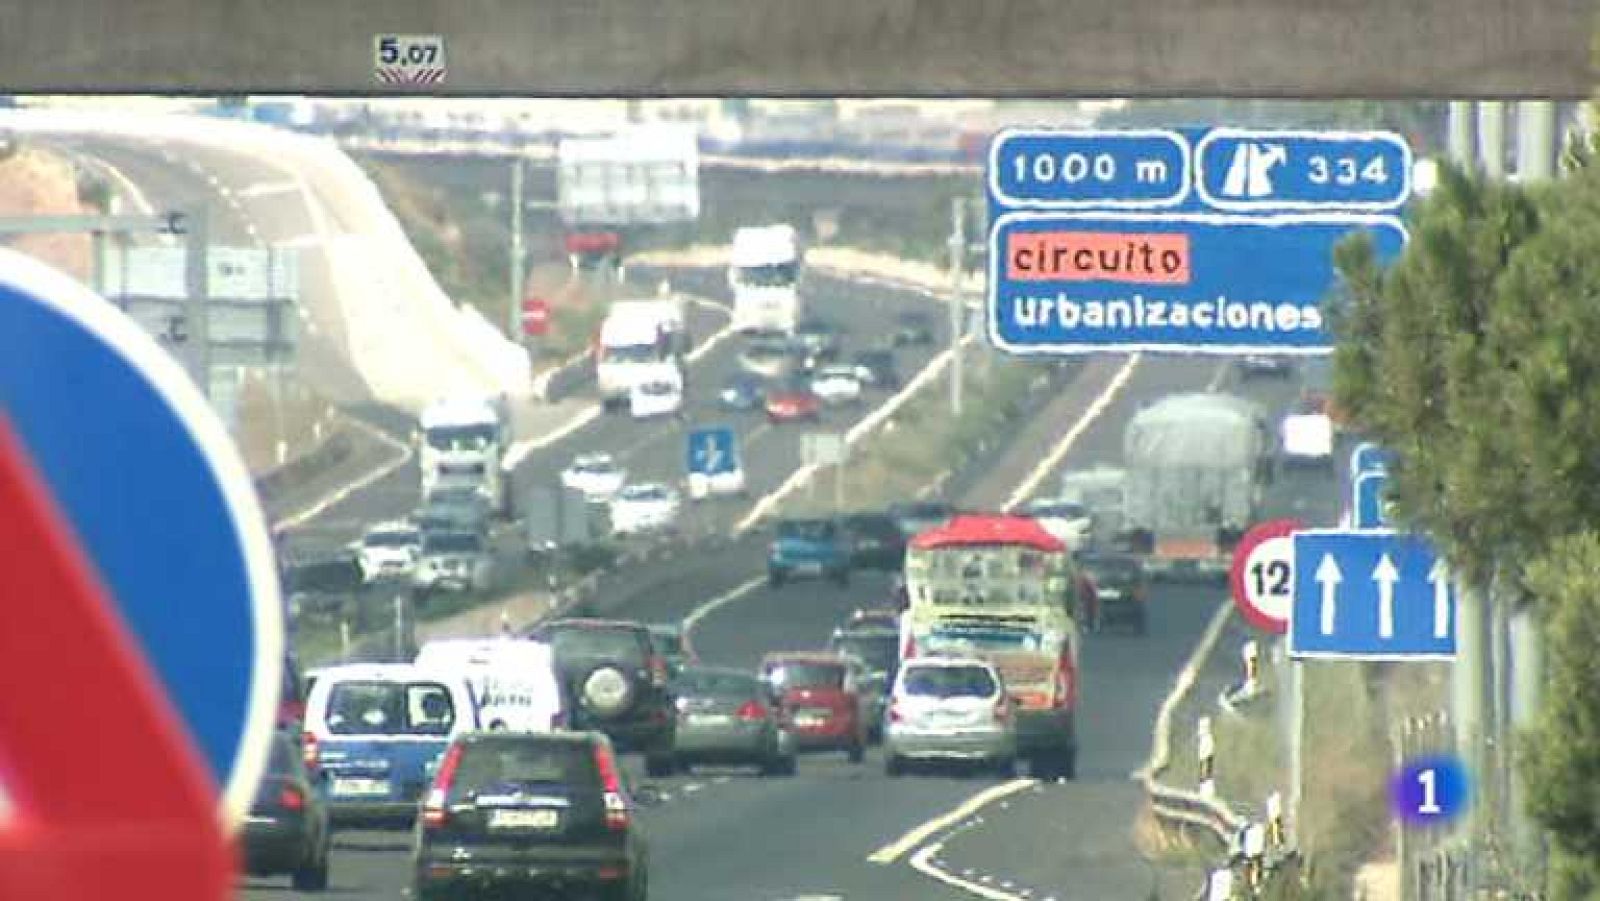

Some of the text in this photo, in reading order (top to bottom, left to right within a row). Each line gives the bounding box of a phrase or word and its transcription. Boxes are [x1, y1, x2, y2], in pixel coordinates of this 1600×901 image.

[1013, 152, 1168, 184] 1000 m
[1307, 155, 1389, 186] 334
[1013, 240, 1182, 275] circuito
[1013, 293, 1323, 331] urbanizaciones
[1251, 560, 1290, 596] 12
